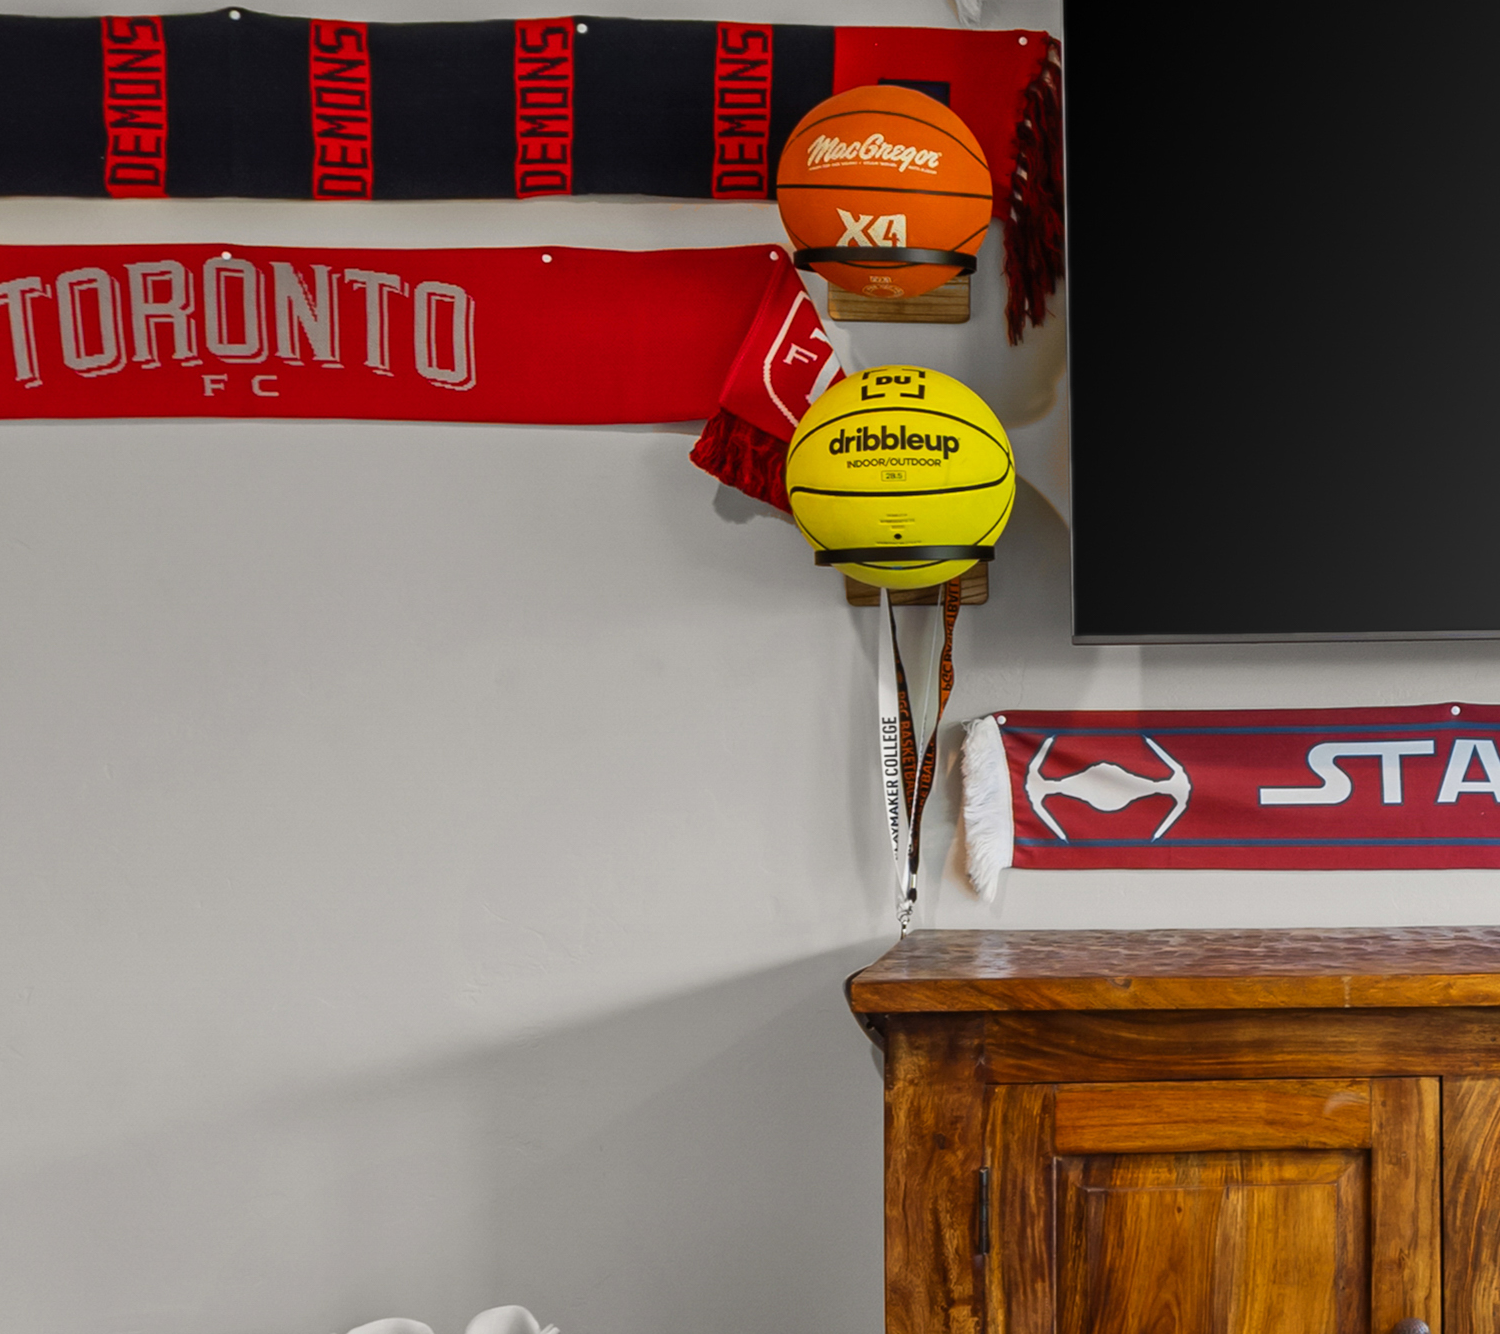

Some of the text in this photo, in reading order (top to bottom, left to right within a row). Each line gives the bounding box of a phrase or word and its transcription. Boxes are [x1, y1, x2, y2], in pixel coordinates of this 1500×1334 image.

[107, 16, 164, 190] DEMONS
[313, 25, 370, 198] DEMONS
[518, 24, 571, 195] DEMONS
[715, 25, 771, 195] DEMONS
[807, 133, 940, 173] MacGregor
[875, 375, 912, 386] DU
[829, 425, 960, 460] dribbleup
[846, 457, 942, 468] INDOOR/OUTDOOR
[882, 716, 898, 776] COLLEGE
